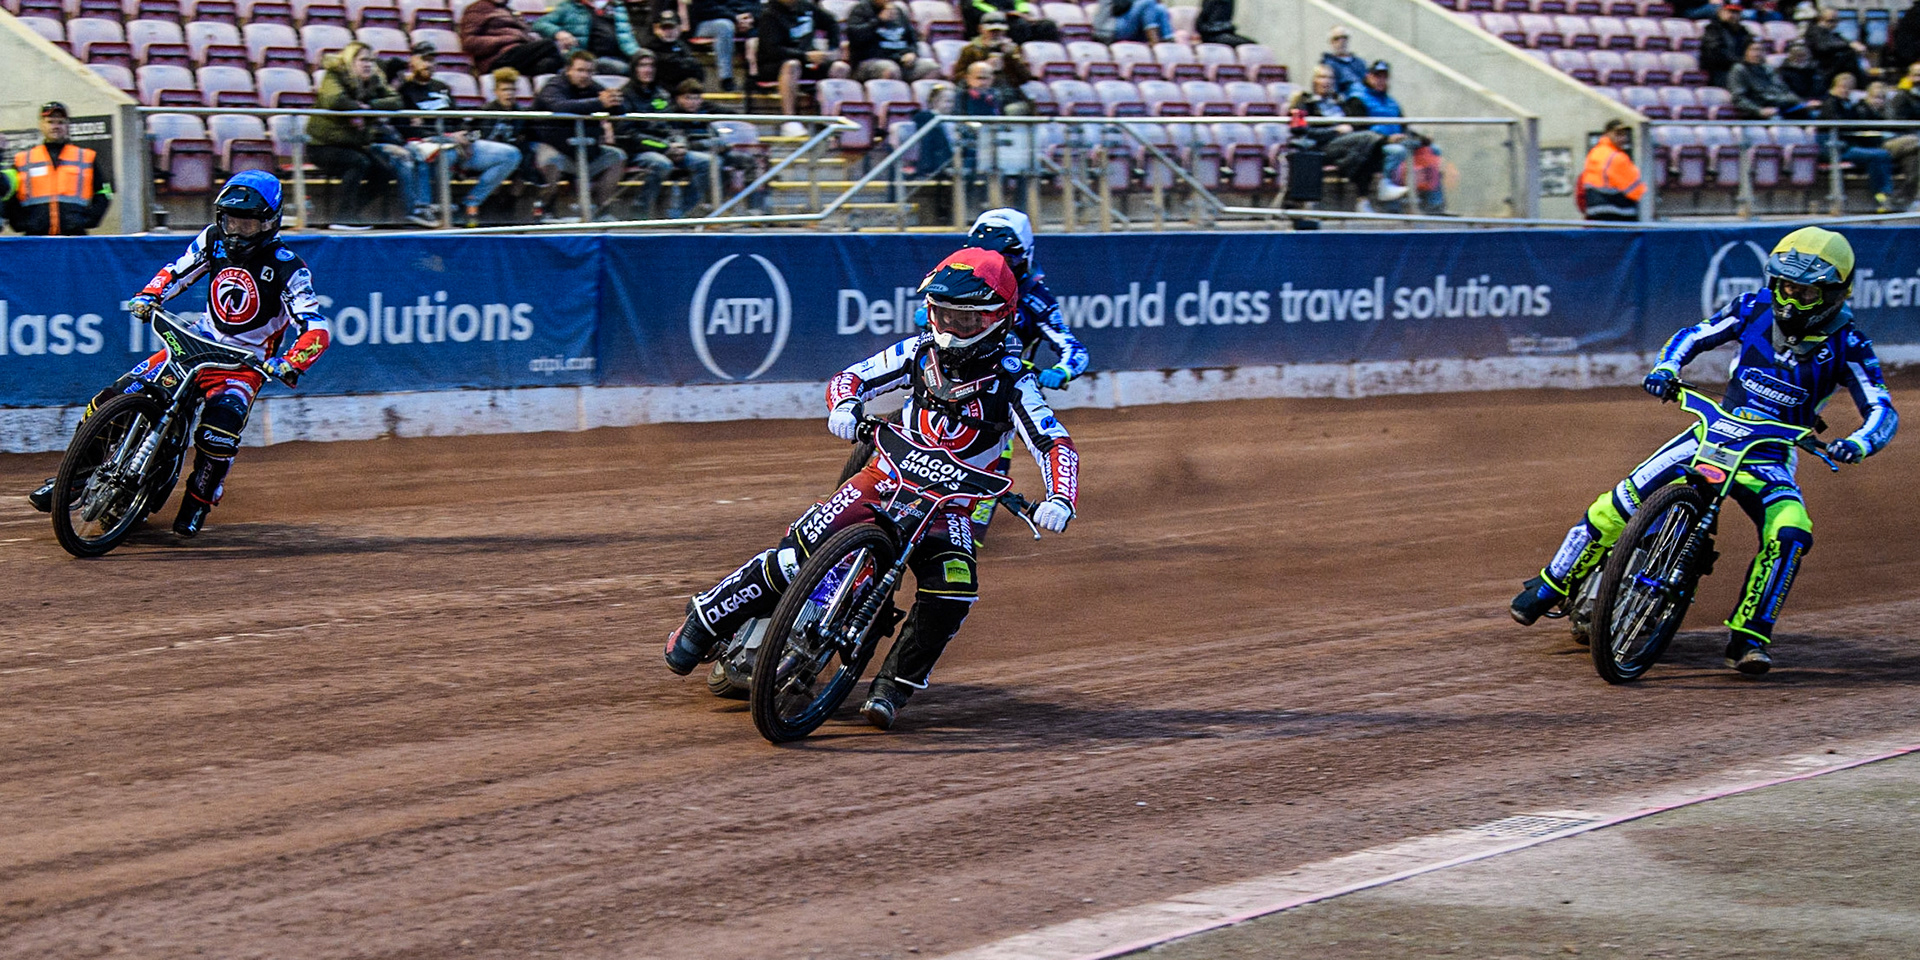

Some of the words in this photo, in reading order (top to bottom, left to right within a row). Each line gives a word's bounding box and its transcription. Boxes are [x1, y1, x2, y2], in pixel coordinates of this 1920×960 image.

[263, 269, 272, 280] 4
[706, 298, 774, 335] ATPI
[1056, 281, 1167, 328] world
[1174, 280, 1271, 326] class
[1280, 276, 1385, 323] travel
[1392, 273, 1552, 320] solutions
[162, 330, 187, 357] FORK
[1817, 347, 1830, 360] 2
[1744, 379, 1799, 405] CHARGERS
[899, 459, 961, 491] SHOCKS
[905, 449, 968, 482] HAGON
[1057, 444, 1071, 496] HAGON
[802, 483, 856, 536] HAGON
[807, 488, 862, 544] SHOCKS
[705, 582, 763, 624] DUGARD
